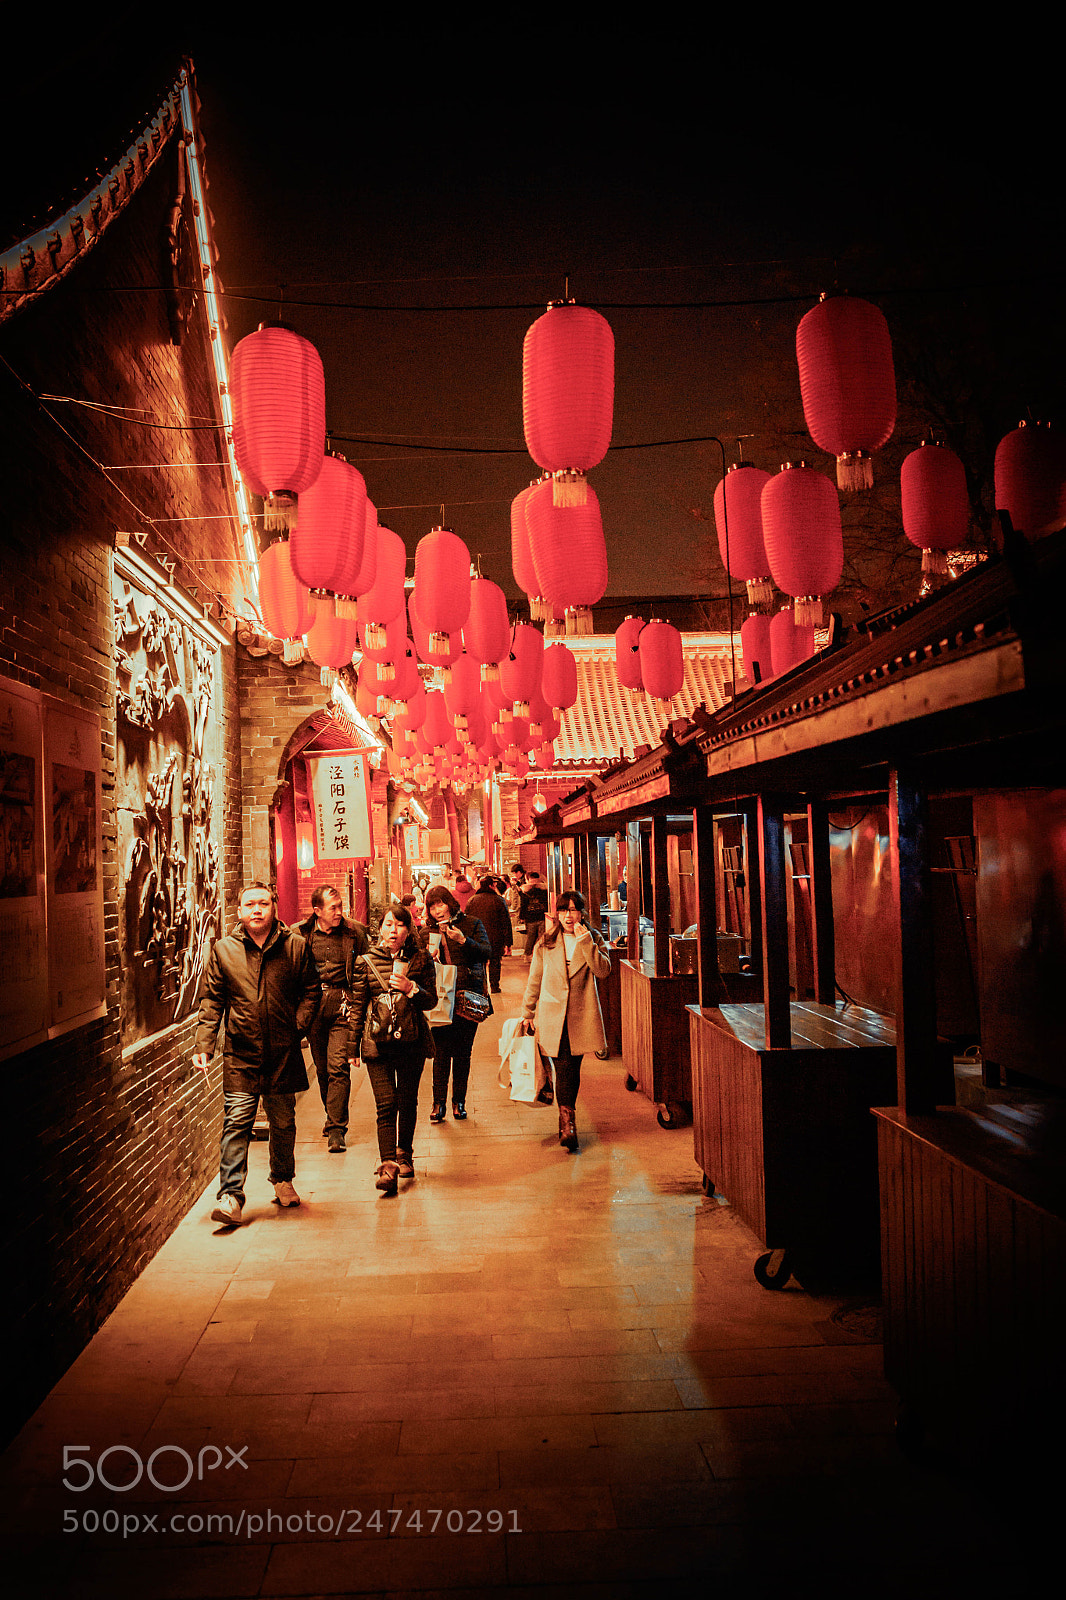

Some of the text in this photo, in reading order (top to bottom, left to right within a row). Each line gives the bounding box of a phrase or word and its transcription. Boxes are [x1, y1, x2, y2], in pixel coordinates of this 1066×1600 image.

[329, 765, 350, 851] 泾阳石子馍
